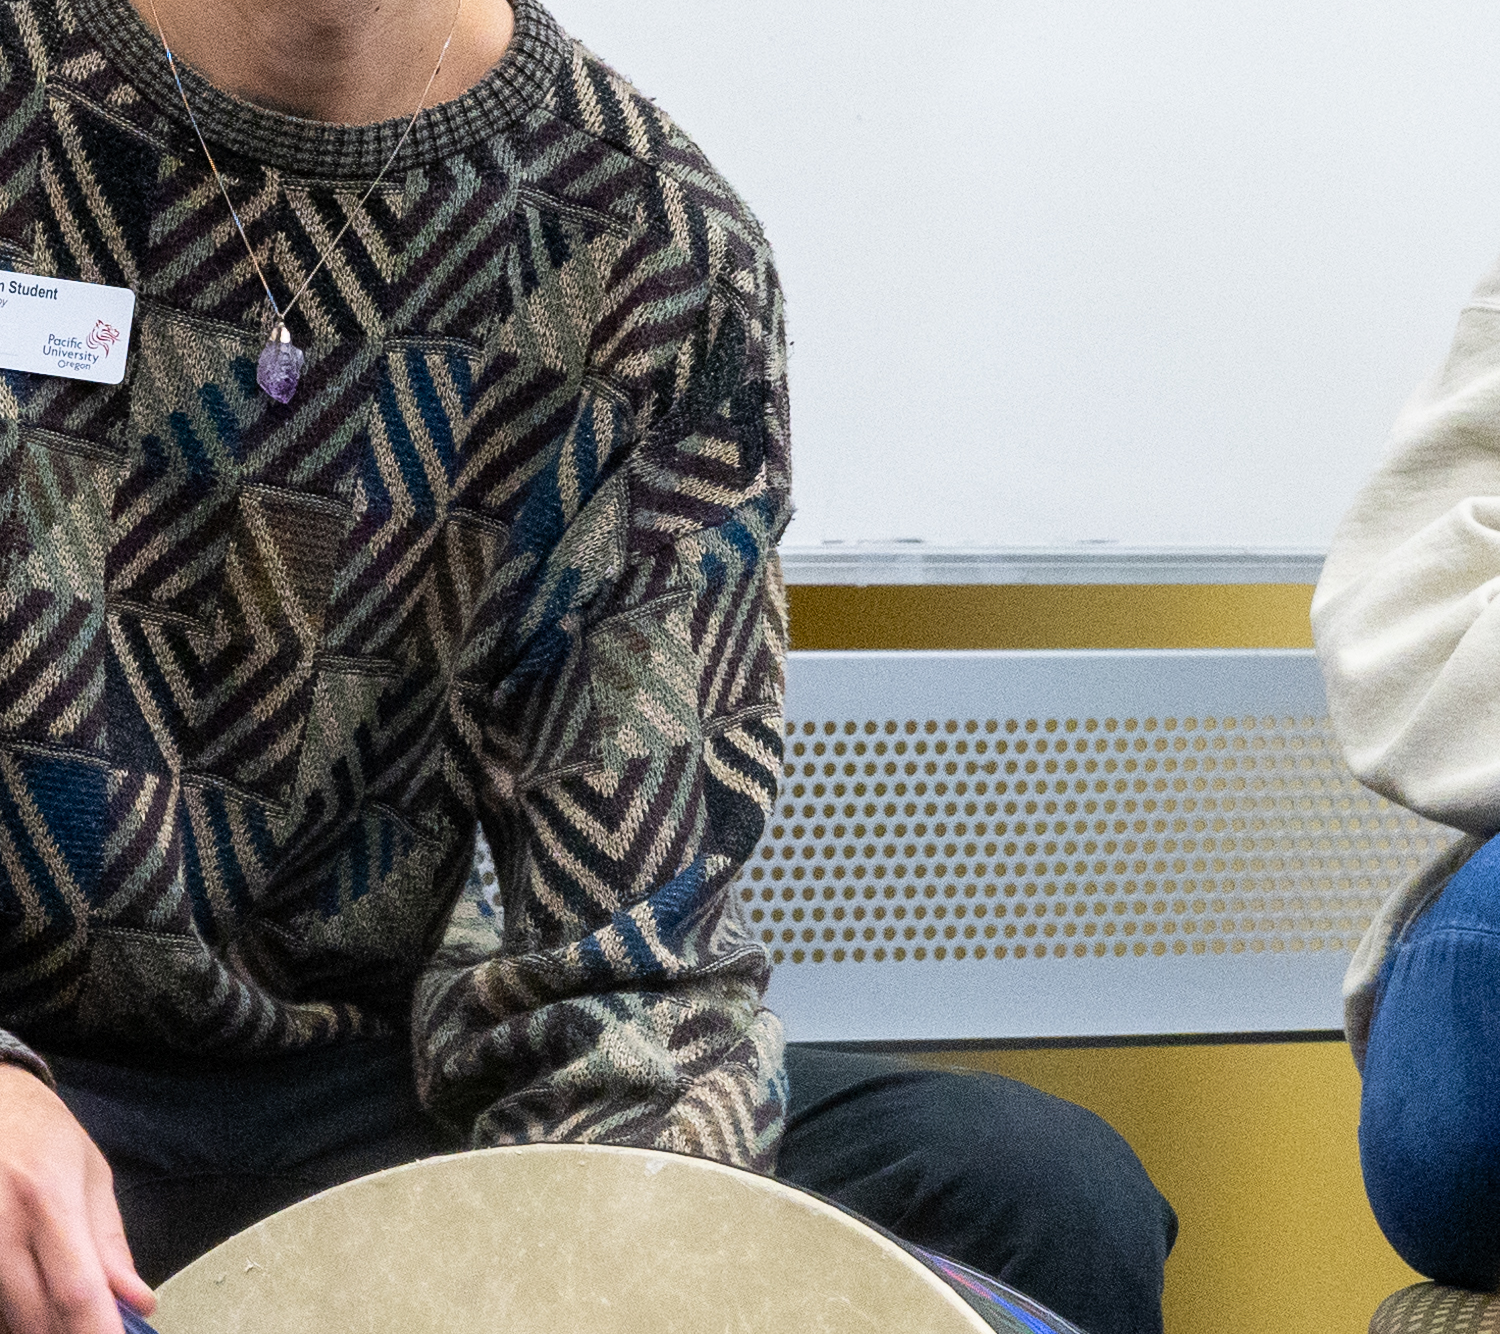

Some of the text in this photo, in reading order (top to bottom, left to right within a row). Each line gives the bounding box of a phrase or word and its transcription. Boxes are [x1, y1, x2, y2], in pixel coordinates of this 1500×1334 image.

[8, 280, 59, 300] Student
[47, 333, 83, 349] Pacific
[42, 345, 100, 364] University
[57, 359, 91, 371] Oregon
